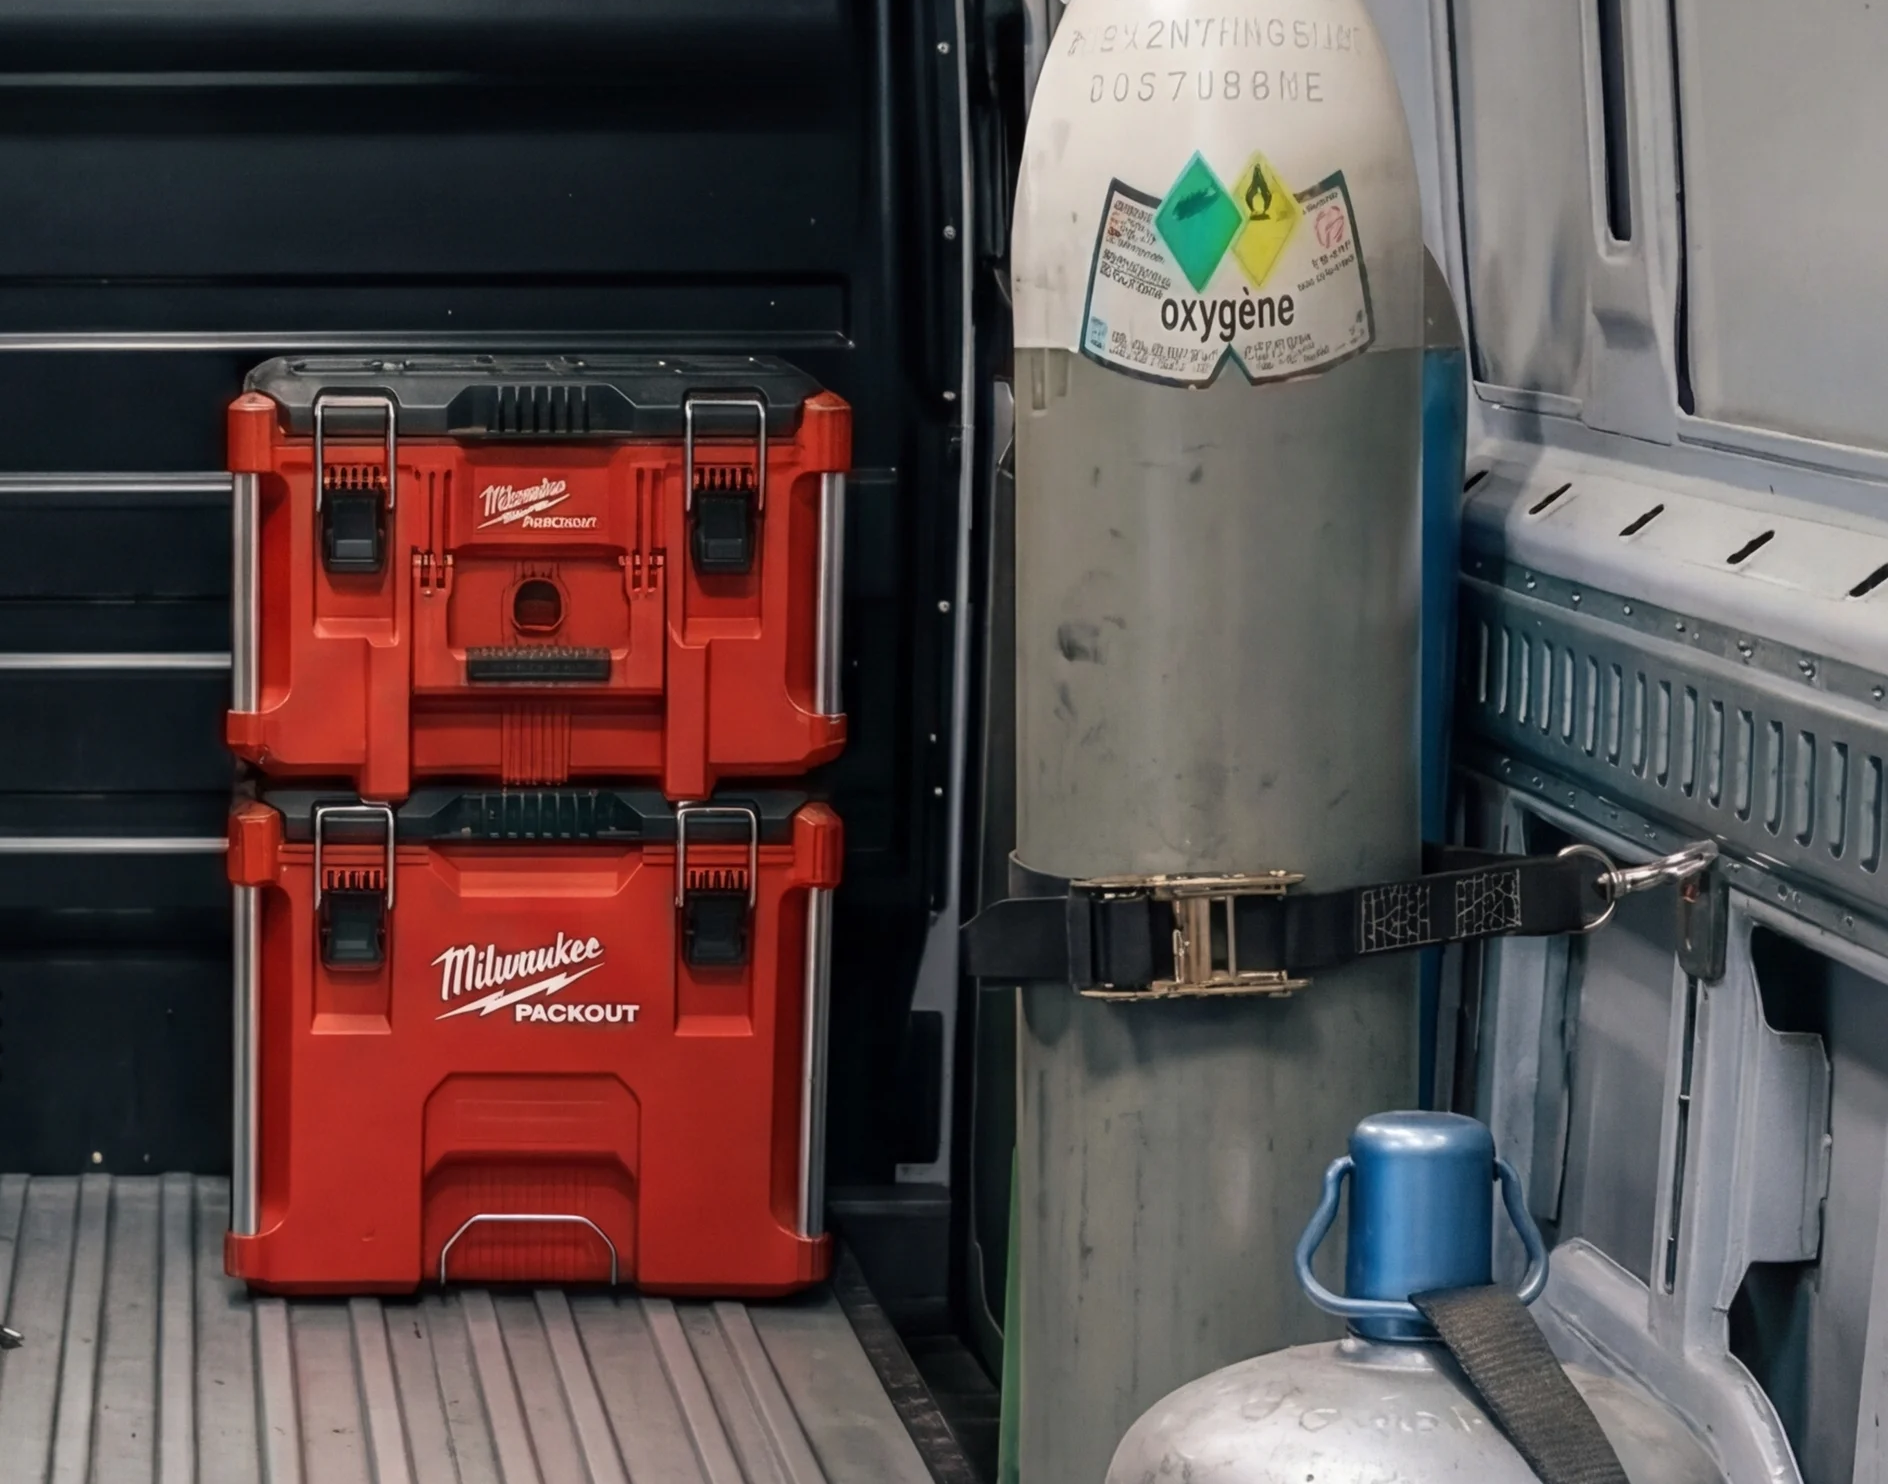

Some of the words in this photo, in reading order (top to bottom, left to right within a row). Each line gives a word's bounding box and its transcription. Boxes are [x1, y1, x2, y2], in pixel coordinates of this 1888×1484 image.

[1160, 286, 1294, 344] oxygène
[431, 931, 605, 1001] Milwaukee
[515, 1003, 640, 1023] PACKOUT
